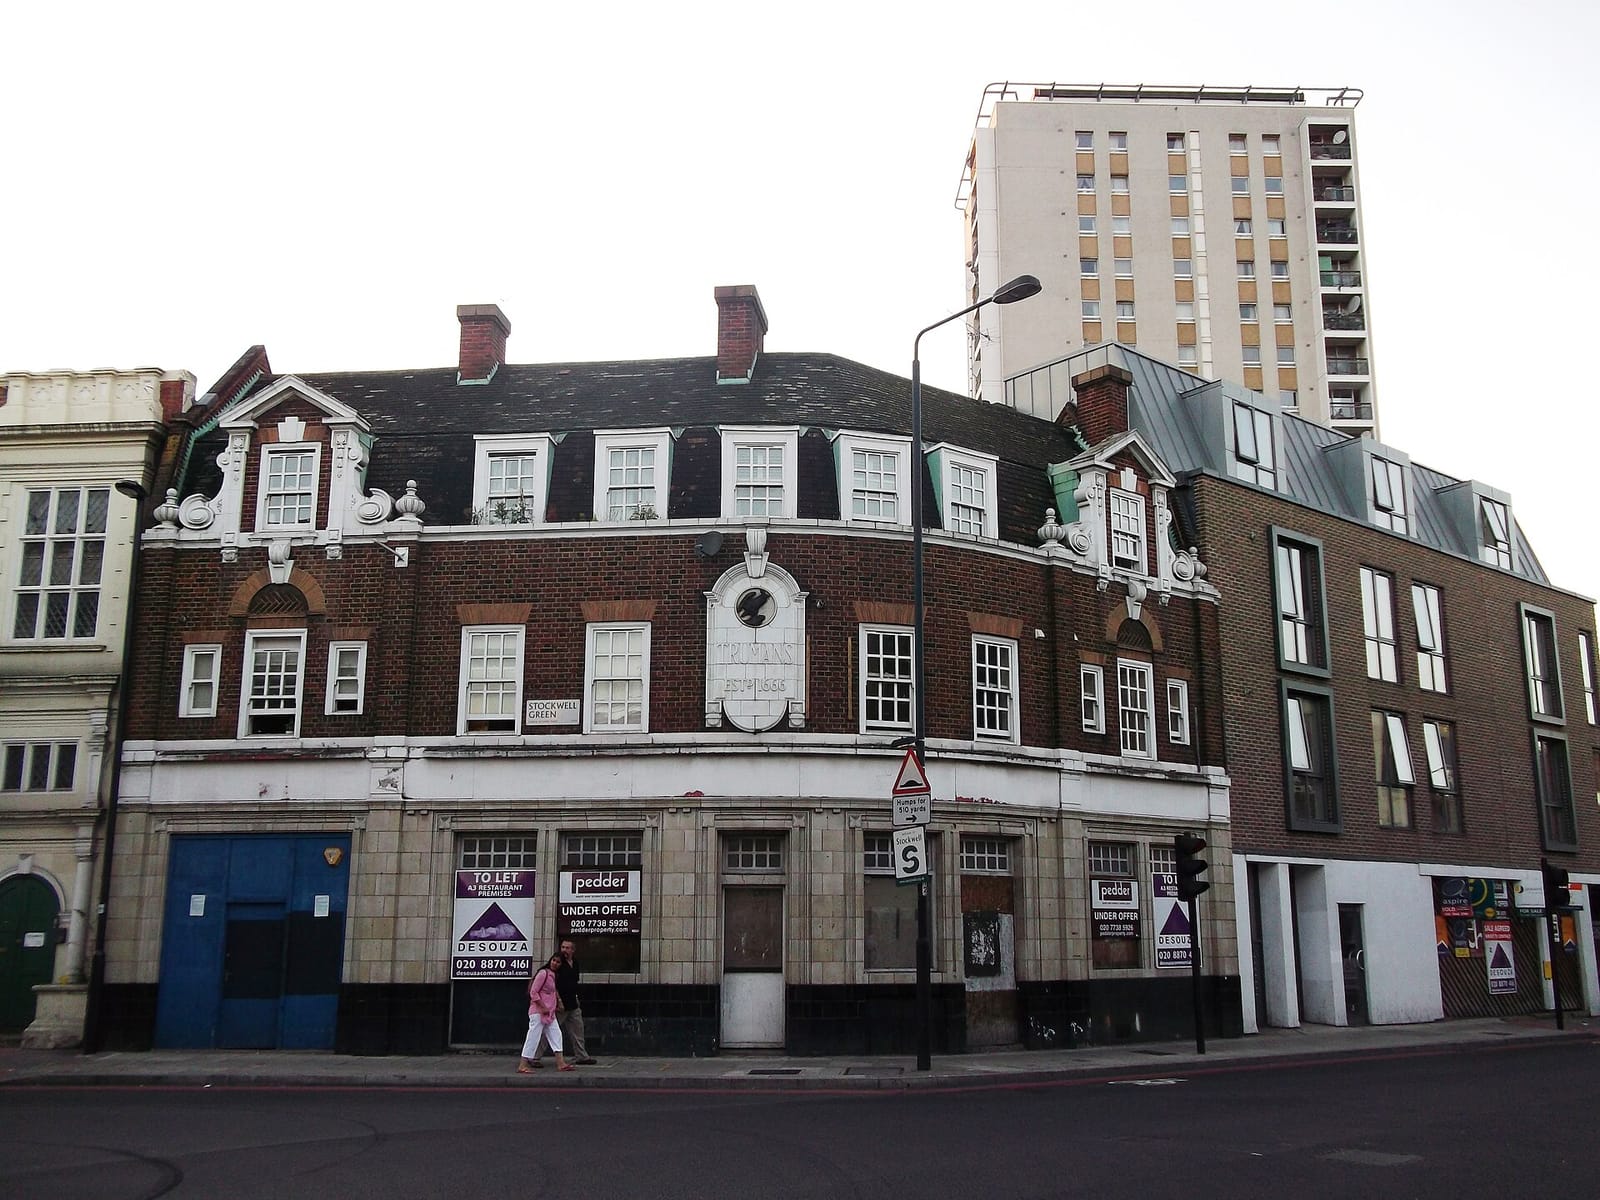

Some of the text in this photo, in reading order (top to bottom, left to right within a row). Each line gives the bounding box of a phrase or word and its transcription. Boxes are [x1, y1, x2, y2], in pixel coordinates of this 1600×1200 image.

[757, 680, 786, 692] 1666
[896, 834, 922, 845] Stockwell
[902, 845, 919, 873] S
[474, 872, 518, 883] TO LET
[576, 872, 625, 894] pedder
[1162, 875, 1172, 884] TO
[1102, 882, 1130, 900] pedder
[562, 906, 636, 916] UNDER OFFER
[458, 943, 528, 952] DESOUZA
[1158, 951, 1170, 959] 020
[456, 960, 528, 968] 020 8870 4161
